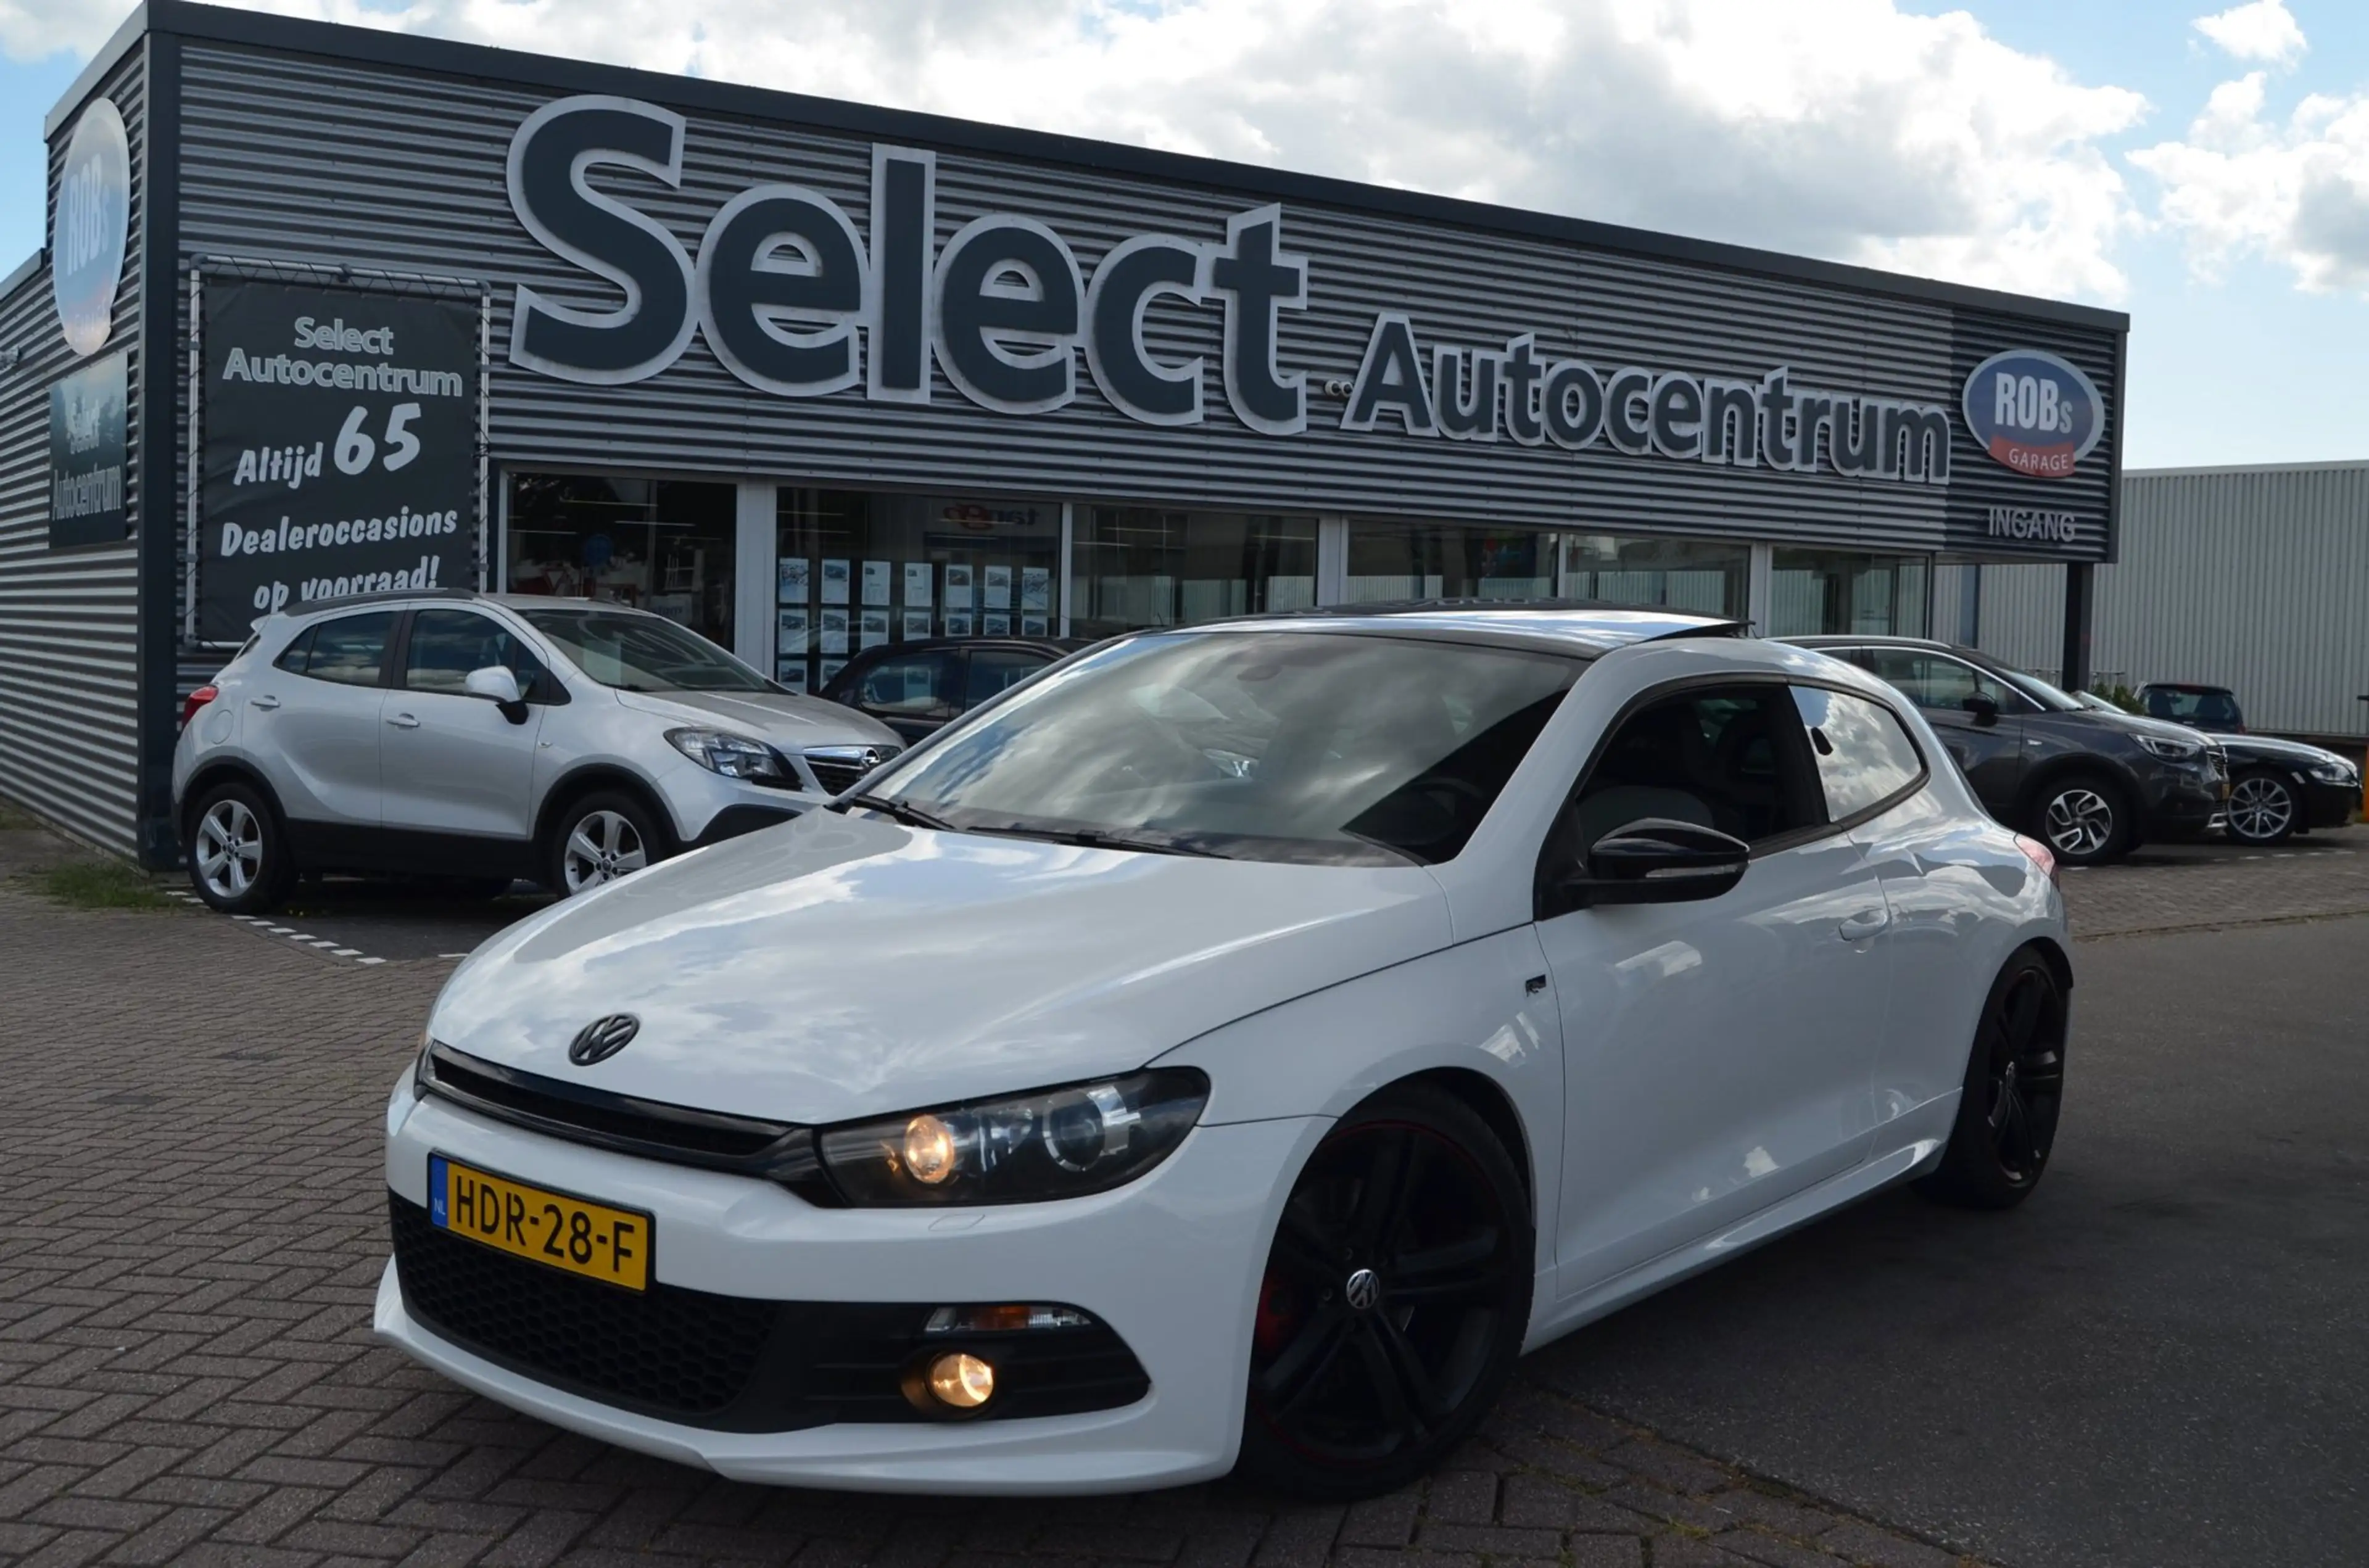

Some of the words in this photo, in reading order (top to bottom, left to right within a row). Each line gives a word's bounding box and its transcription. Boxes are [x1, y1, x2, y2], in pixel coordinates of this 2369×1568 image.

[506, 93, 1307, 435] Select
[1339, 311, 1950, 485] Autocentrum
[294, 316, 395, 357] Select
[222, 347, 463, 398] Autocentrum
[1995, 371, 2073, 434] ROBs
[234, 442, 324, 490] Altijd
[333, 402, 422, 476] 65
[2008, 447, 2069, 471] GARAGE
[52, 462, 122, 521] Autocentrum
[220, 506, 458, 558] Dealeroccasions
[1988, 506, 2075, 542] INGANG
[253, 580, 290, 614] op
[301, 555, 440, 601] voorraad!
[434, 1197, 446, 1216] NL
[456, 1174, 635, 1273] HDR-28-F
